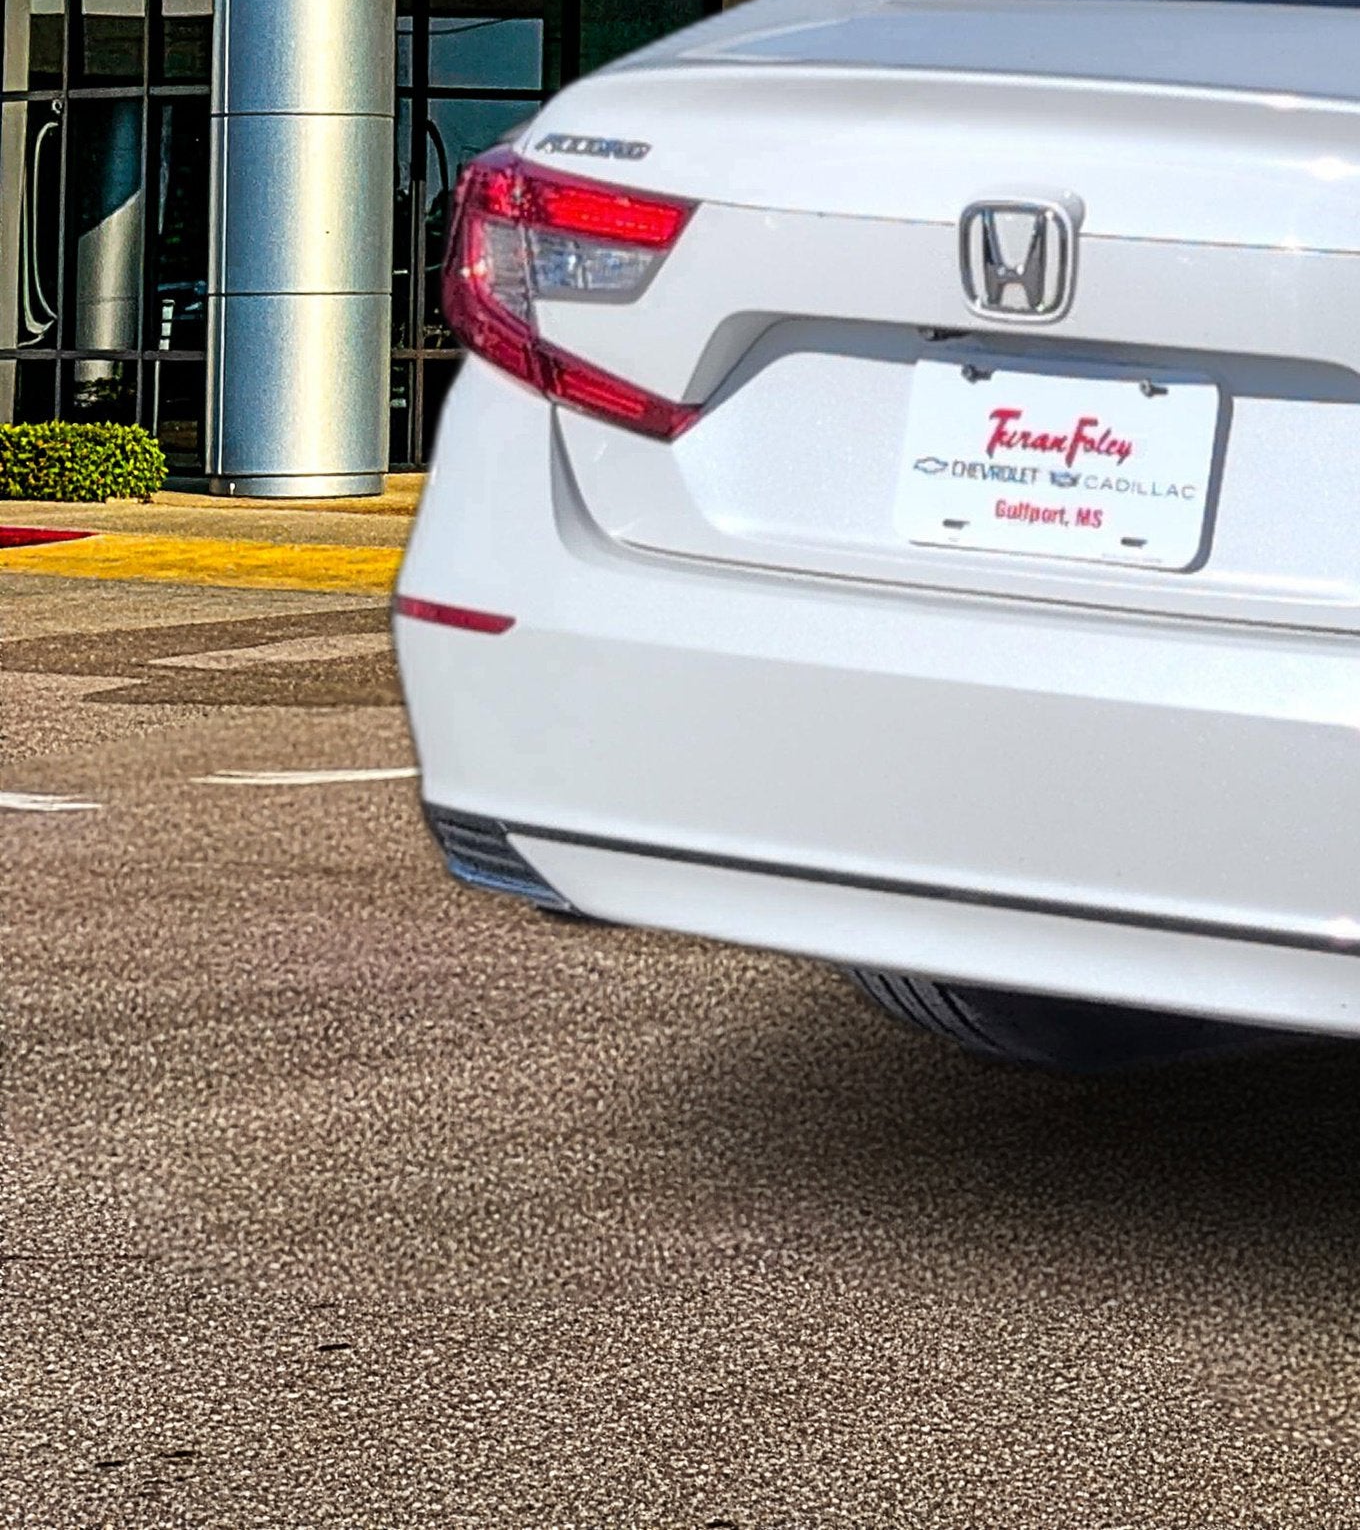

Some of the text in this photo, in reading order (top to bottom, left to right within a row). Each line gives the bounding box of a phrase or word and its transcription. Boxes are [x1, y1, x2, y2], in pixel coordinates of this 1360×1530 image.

[952, 459, 1196, 500] CHEVROLET CADILLAC
[1075, 508, 1104, 529] MS
